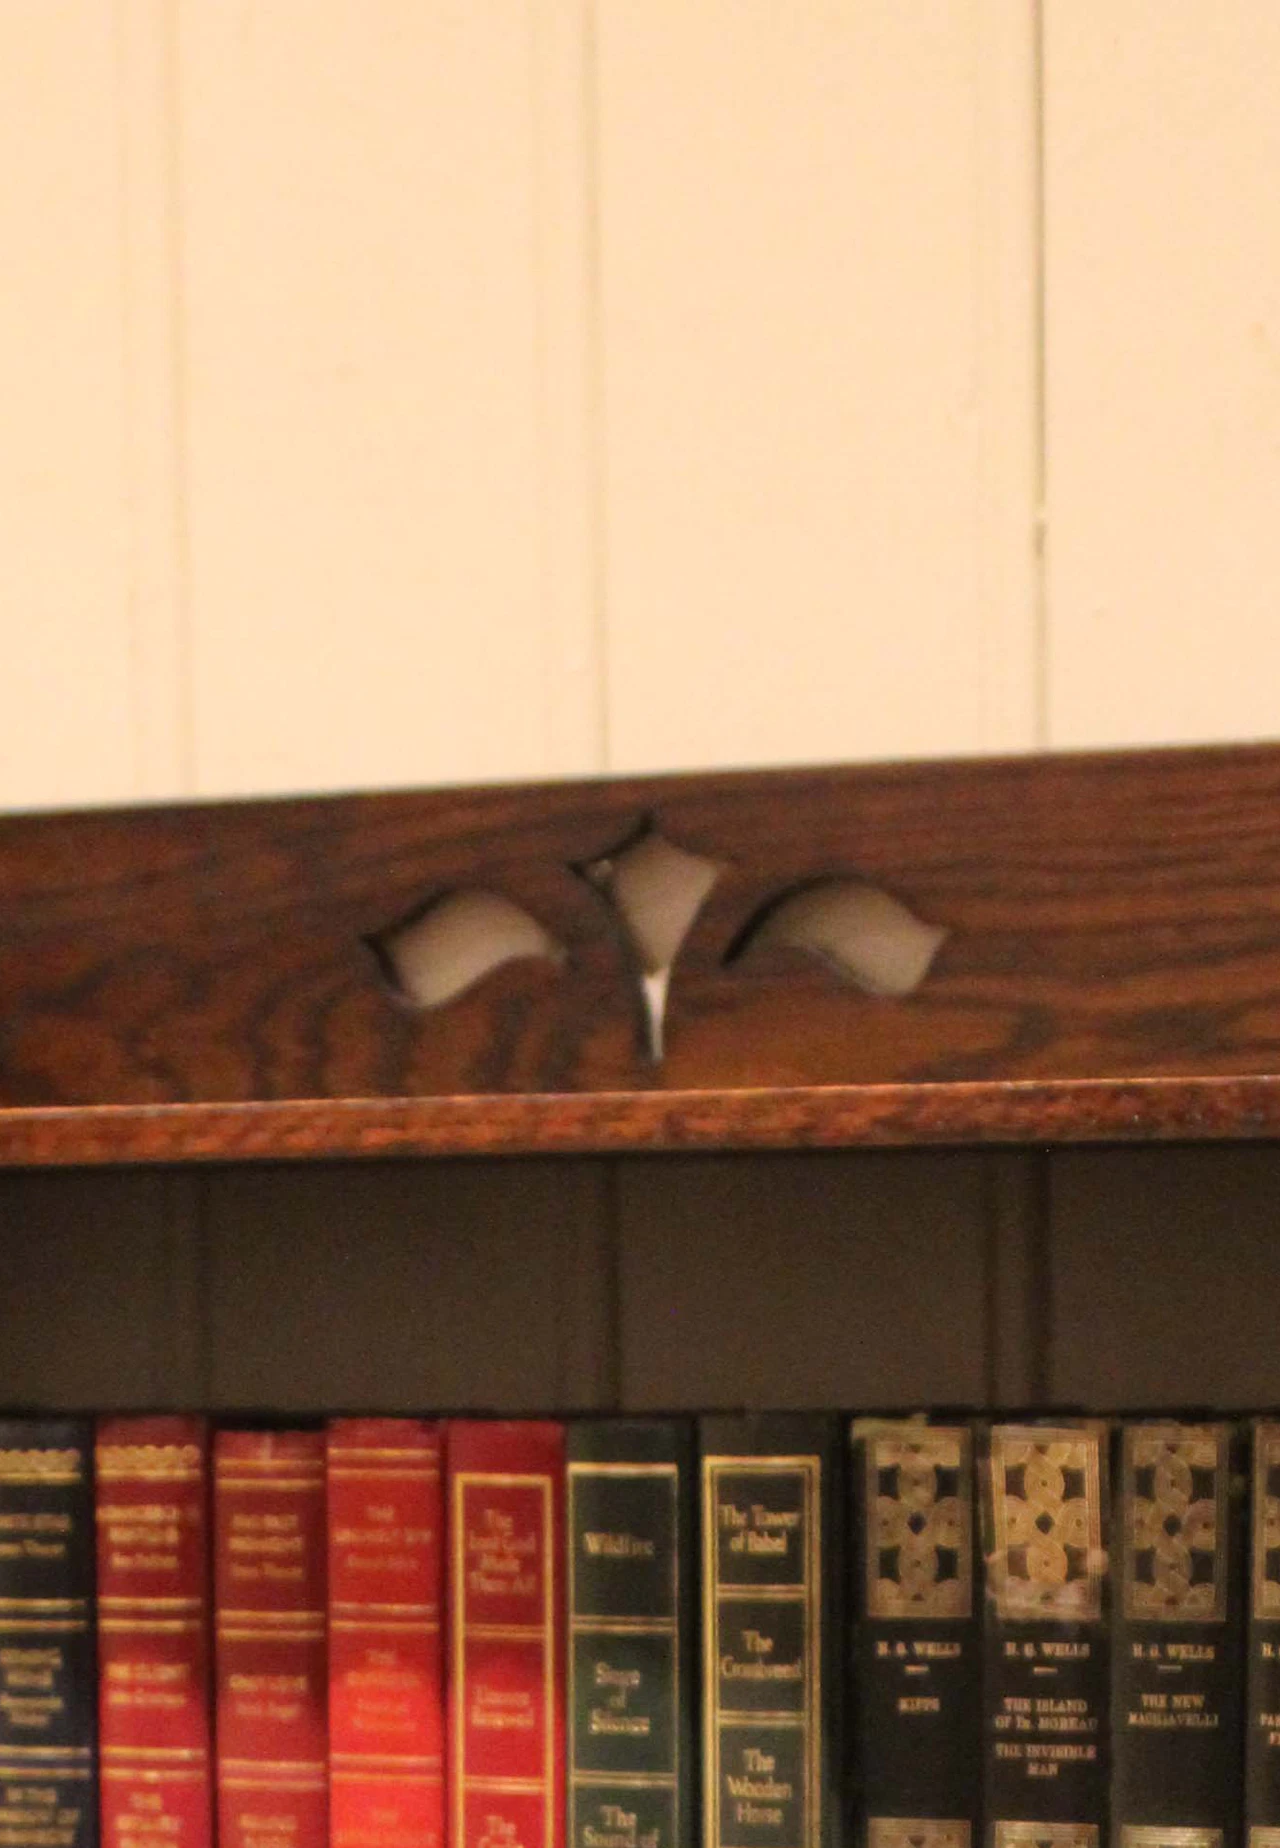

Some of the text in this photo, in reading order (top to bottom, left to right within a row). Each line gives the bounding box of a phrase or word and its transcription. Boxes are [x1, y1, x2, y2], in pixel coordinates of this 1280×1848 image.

[719, 1504, 747, 1528] The
[742, 1629, 773, 1653] The
[1041, 1642, 1091, 1658] WELLS
[1165, 1643, 1215, 1661] WELLS
[743, 1747, 775, 1772] The
